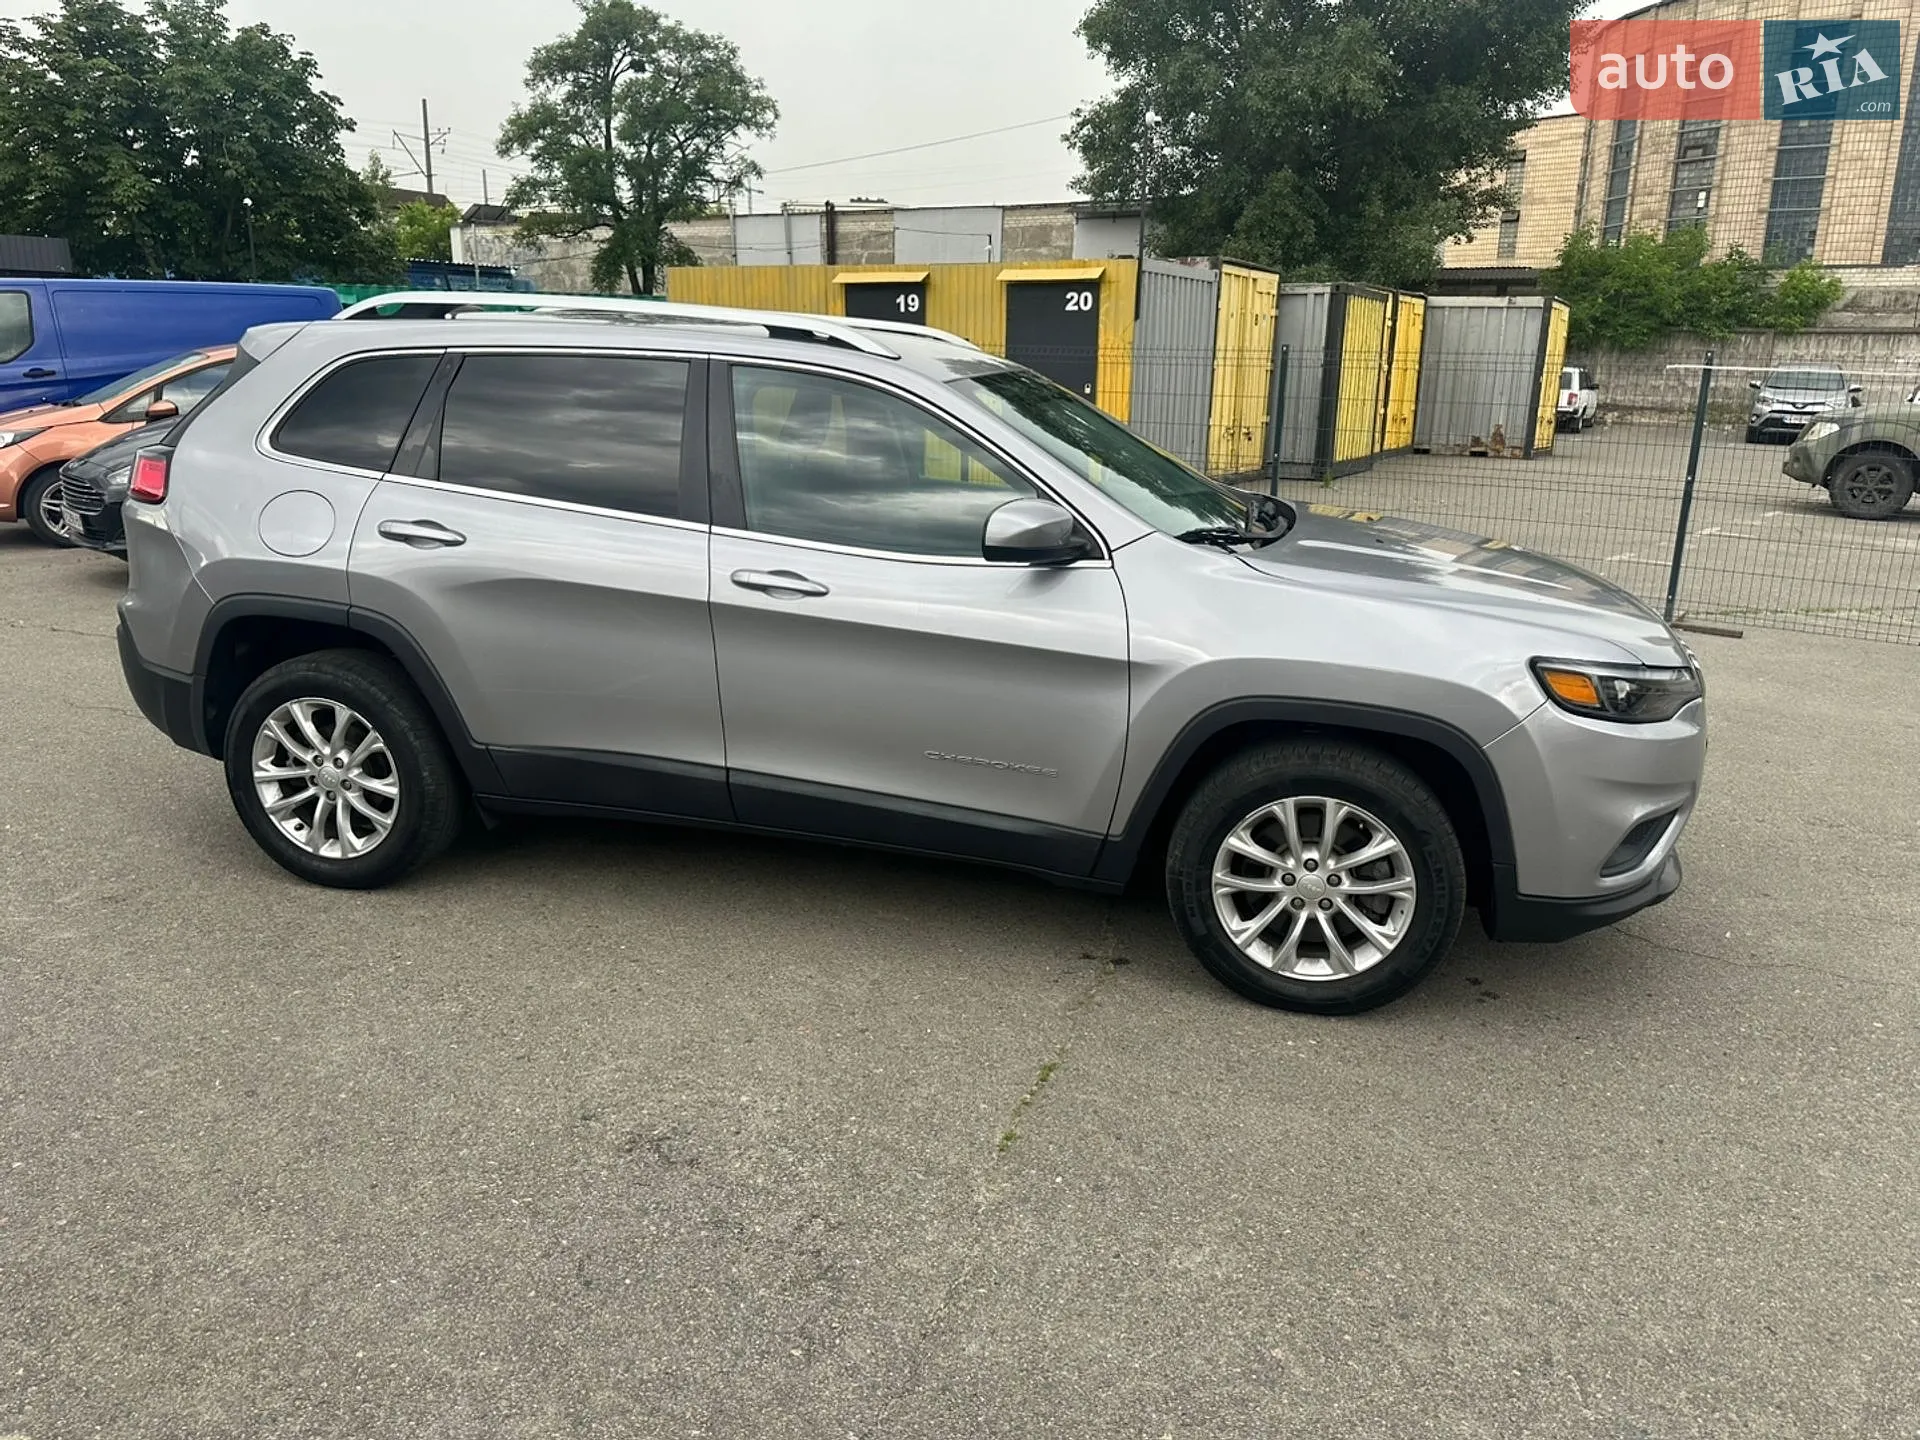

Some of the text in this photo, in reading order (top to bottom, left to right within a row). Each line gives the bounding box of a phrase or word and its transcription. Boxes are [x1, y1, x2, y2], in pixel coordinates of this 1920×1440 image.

[895, 294, 920, 313] 19
[1064, 291, 1094, 311] 20
[923, 750, 1059, 778] CHEROKEE
